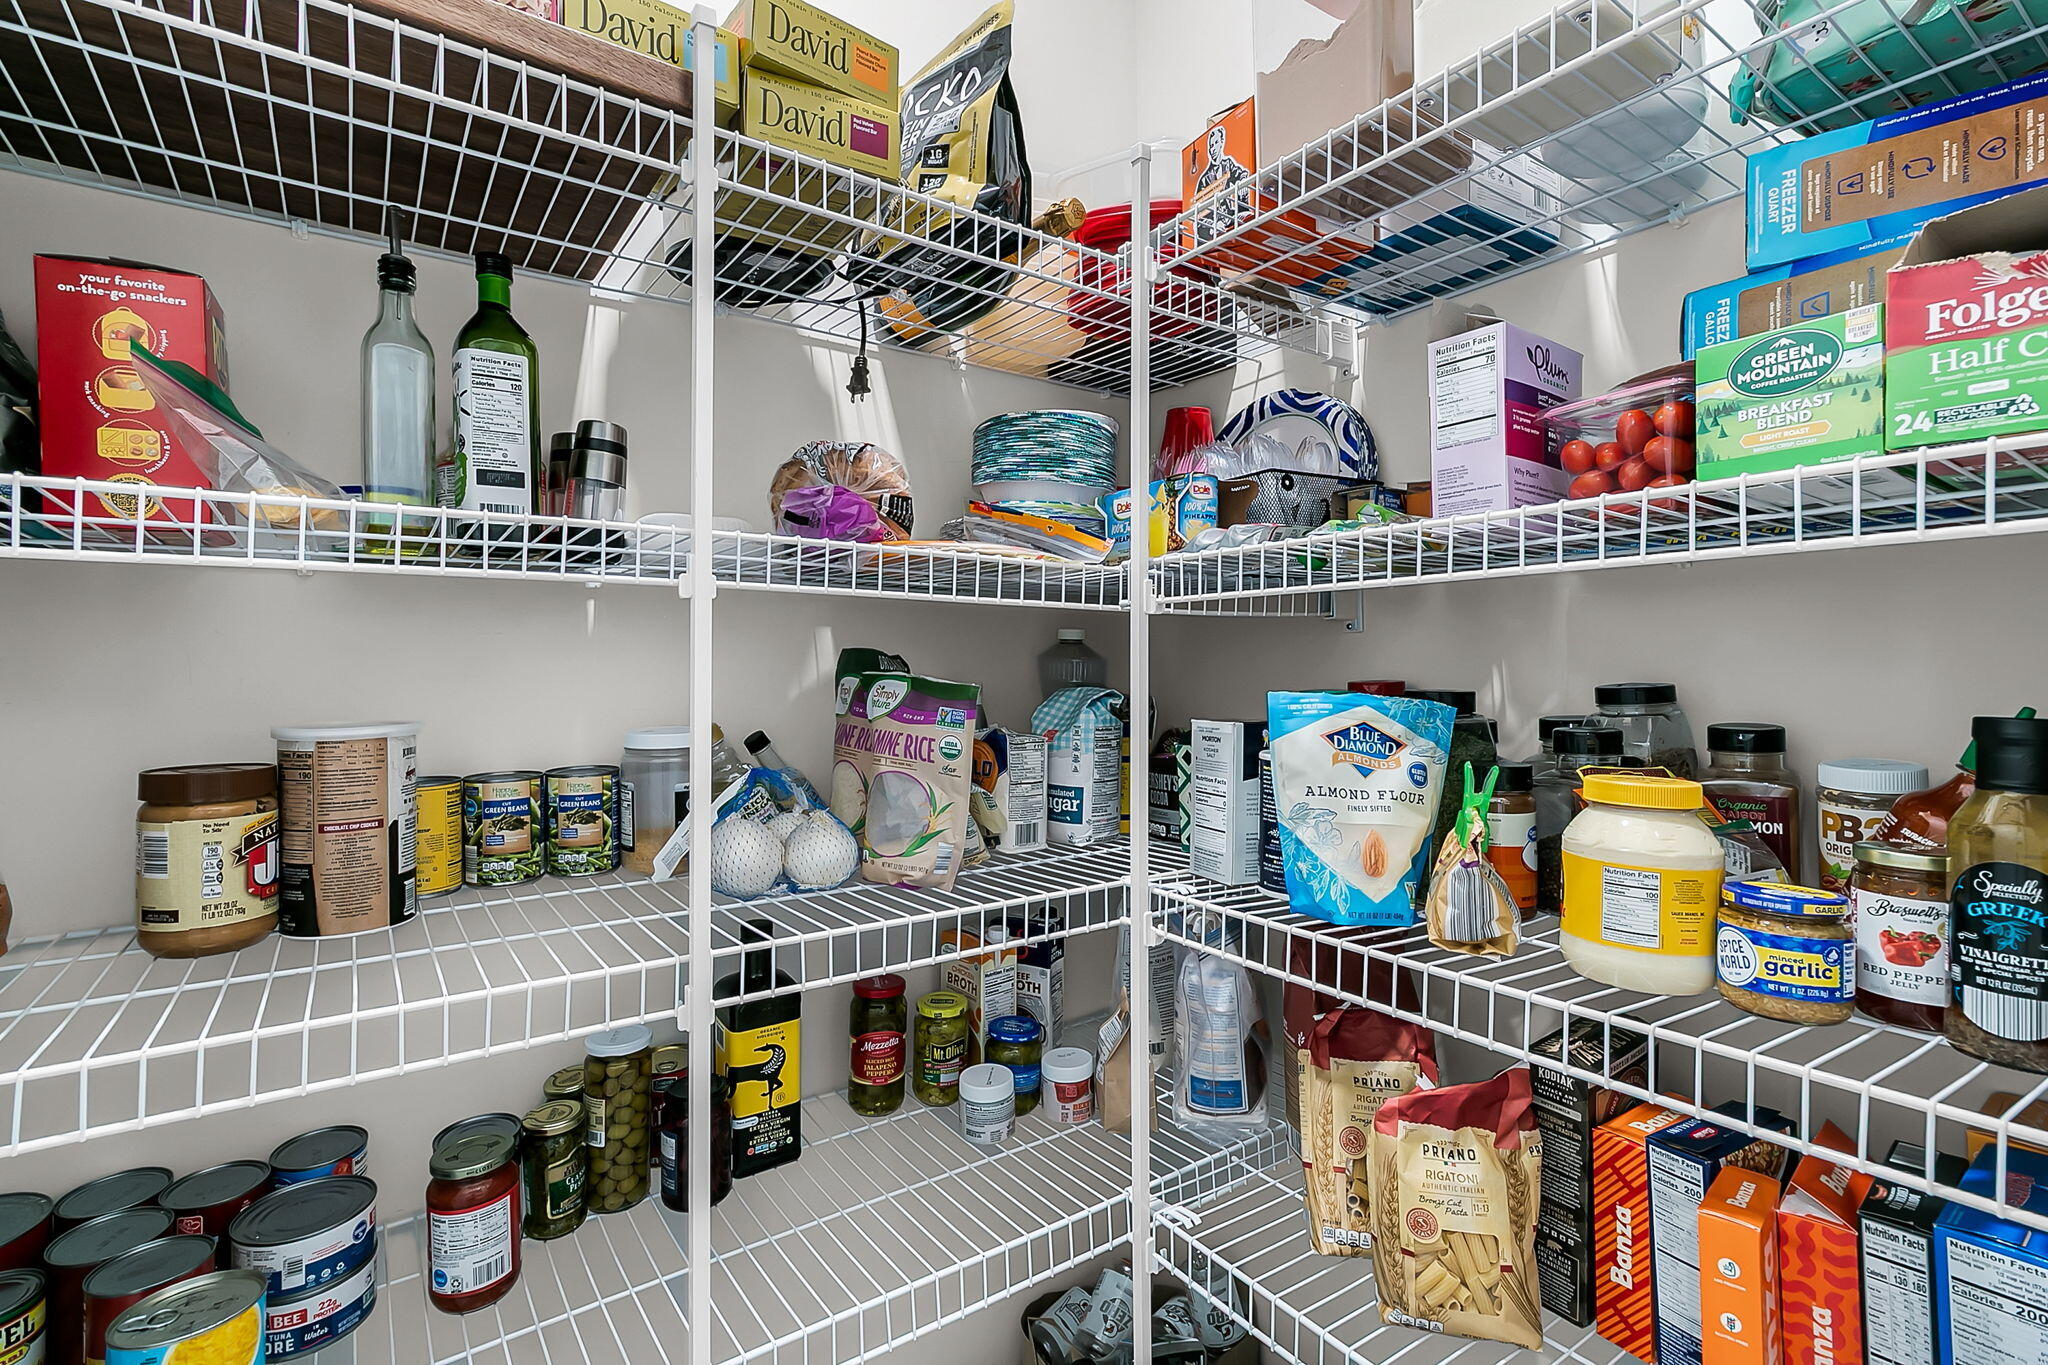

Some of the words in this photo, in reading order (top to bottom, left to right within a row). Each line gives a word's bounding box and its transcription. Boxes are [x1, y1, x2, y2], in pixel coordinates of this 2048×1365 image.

[579, 0, 680, 64] David
[766, 1, 849, 75] David
[759, 86, 846, 147] David
[1877, 116, 1909, 128] Mindfully
[1910, 109, 1930, 119] made
[1768, 187, 1779, 223] QUART
[1781, 168, 1797, 235] FREEZER
[1859, 236, 1895, 251] Mindfully
[79, 272, 111, 286] your
[114, 274, 166, 292] favorite
[57, 282, 126, 302] on-the-go
[129, 291, 188, 307] snackers
[1925, 286, 2048, 334] Folge
[1705, 312, 1715, 345] GALLO
[1717, 298, 1730, 343] FREEZ
[1925, 331, 1956, 340] PROUDLY
[1957, 324, 1991, 334] ROASTED
[1436, 341, 1470, 356] Nutrition
[1473, 334, 1496, 346] Facts
[471, 356, 501, 365] Nutrition
[1751, 342, 1814, 369] GREEN
[1929, 337, 2010, 375] Half
[1437, 366, 1460, 377] Calories
[1485, 354, 1495, 363] 70
[1526, 344, 1570, 385] Plum
[1737, 352, 1832, 386] MOUNTAIN
[1543, 377, 1567, 392] ORGANICS
[1750, 378, 1779, 390] COFFEE
[1779, 371, 1818, 386] ROASTERS
[1737, 392, 1833, 423] BREAKFAST
[1969, 410, 1998, 420] PODS
[1756, 410, 1813, 431] BLEND
[1893, 410, 1934, 436] 24
[1759, 433, 1783, 442] LIGHT
[1783, 427, 1810, 439] ROAST
[1193, 484, 1211, 495] Dole
[1184, 502, 1202, 512] 100%
[873, 686, 900, 703] Simply
[1201, 735, 1221, 743] MORTON
[1350, 726, 1381, 744] BLUE
[904, 733, 936, 764] RICE
[944, 740, 958, 748] USDA
[1334, 735, 1397, 756] DIAMOND
[292, 752, 312, 760] Facts
[1337, 752, 1397, 769] ALMONDS
[298, 772, 312, 780] 190
[1411, 767, 1426, 776] GLUTEN
[1413, 774, 1425, 782] FREE
[1195, 775, 1214, 784] Nutrition
[1214, 778, 1227, 786] Facts
[580, 799, 600, 807] BEANS
[1305, 785, 1370, 800] ALMOND
[1377, 790, 1425, 806] FLOUR
[507, 804, 529, 812] BEANS
[1347, 804, 1368, 812] FINELY
[1370, 804, 1392, 813] SIFTED
[1716, 797, 1768, 811] Organic
[1719, 809, 1767, 821] SAIGON
[323, 823, 349, 832] CHOCOLATE
[360, 821, 379, 829] COOKIES
[207, 847, 219, 855] 190
[1825, 842, 1851, 856] ORIG
[1604, 867, 1636, 878] Nutrition
[1638, 872, 1659, 880] Facts
[1604, 887, 1626, 895] Calories
[1973, 870, 2043, 904] Specially
[1992, 891, 2030, 900] SELECTED
[201, 904, 213, 912] NET
[213, 903, 223, 911] WT
[1815, 905, 1844, 915] GARLIC
[1867, 898, 1945, 921] Braswell's
[1967, 901, 2048, 928] GREEK
[1720, 939, 1744, 954] SPICE
[1720, 954, 1751, 970] WORLD
[1769, 954, 1804, 965] minced
[1975, 959, 1993, 968] WINE
[951, 965, 975, 981] CHICKEN
[984, 970, 1002, 978] Nutrition
[1764, 960, 1834, 981] garlic
[1863, 962, 1888, 976] RED
[1894, 971, 1946, 986] PEPPE
[1982, 966, 2013, 978] SPECIAL
[2016, 973, 2045, 983] SPICES
[947, 971, 978, 997] BROTH
[1767, 983, 1779, 992] NET
[1889, 979, 1921, 990] JELLY
[1976, 976, 1987, 985] NET
[860, 1036, 899, 1052] Mezzetta
[933, 1047, 944, 1061] Mt.
[945, 1043, 964, 1059] Olive
[864, 1061, 897, 1071] JALAPEÑO
[866, 1069, 895, 1077] PEPPERS
[1353, 1076, 1401, 1089] PRIANO
[1538, 1066, 1576, 1090] KODIAK
[1534, 1082, 1564, 1099] FLAPJACK
[1564, 1094, 1578, 1102] AND
[1538, 1089, 1560, 1101] WAFFLE
[1562, 1098, 1574, 1106] MIX
[1073, 1103, 1090, 1112] BEEF
[749, 1122, 769, 1132] EXTRA
[770, 1116, 791, 1126] VIRGIN
[749, 1136, 769, 1146] EXTRA
[770, 1130, 790, 1139] VIERGE
[1422, 1143, 1476, 1161] PRIANO
[1651, 1146, 1680, 1166] Nutrition
[1681, 1159, 1701, 1173] Facts
[475, 1162, 493, 1174] CLOSE
[1425, 1170, 1479, 1185] RIGATONI
[1422, 1182, 1458, 1193] AUTHENTIC
[1459, 1186, 1485, 1195] ITALIAN
[1652, 1173, 1679, 1190] Calories
[1684, 1186, 1701, 1199] 200
[1419, 1195, 1445, 1207] Bronze
[1446, 1199, 1463, 1208] Cut
[1726, 1181, 1757, 1209] Banza
[1445, 1207, 1469, 1217] Pasta
[1472, 1202, 1490, 1212] 11-13
[1864, 1222, 1900, 1243] Nutrition
[1902, 1234, 1926, 1252] Facts
[1610, 1205, 1633, 1290] Banza
[1949, 1240, 2005, 1265] Nutrition
[2010, 1259, 2047, 1278] Facts
[1950, 1255, 1972, 1267] Serving
[1866, 1267, 1888, 1281] Calories
[1893, 1275, 1908, 1288] 130
[1912, 1281, 1927, 1294] 180
[313, 1303, 342, 1320] PROTEIN
[318, 1298, 337, 1311] 22g
[1952, 1284, 2004, 1310] Calories
[2016, 1305, 2048, 1325] 200
[273, 1312, 302, 1328] BEE
[1953, 1318, 1990, 1336] Cholesterol
[269, 1332, 292, 1342] TUNA
[304, 1327, 329, 1341] Water
[1953, 1325, 1977, 1337] Sodium
[1971, 1338, 2016, 1359] Carbohydrate
